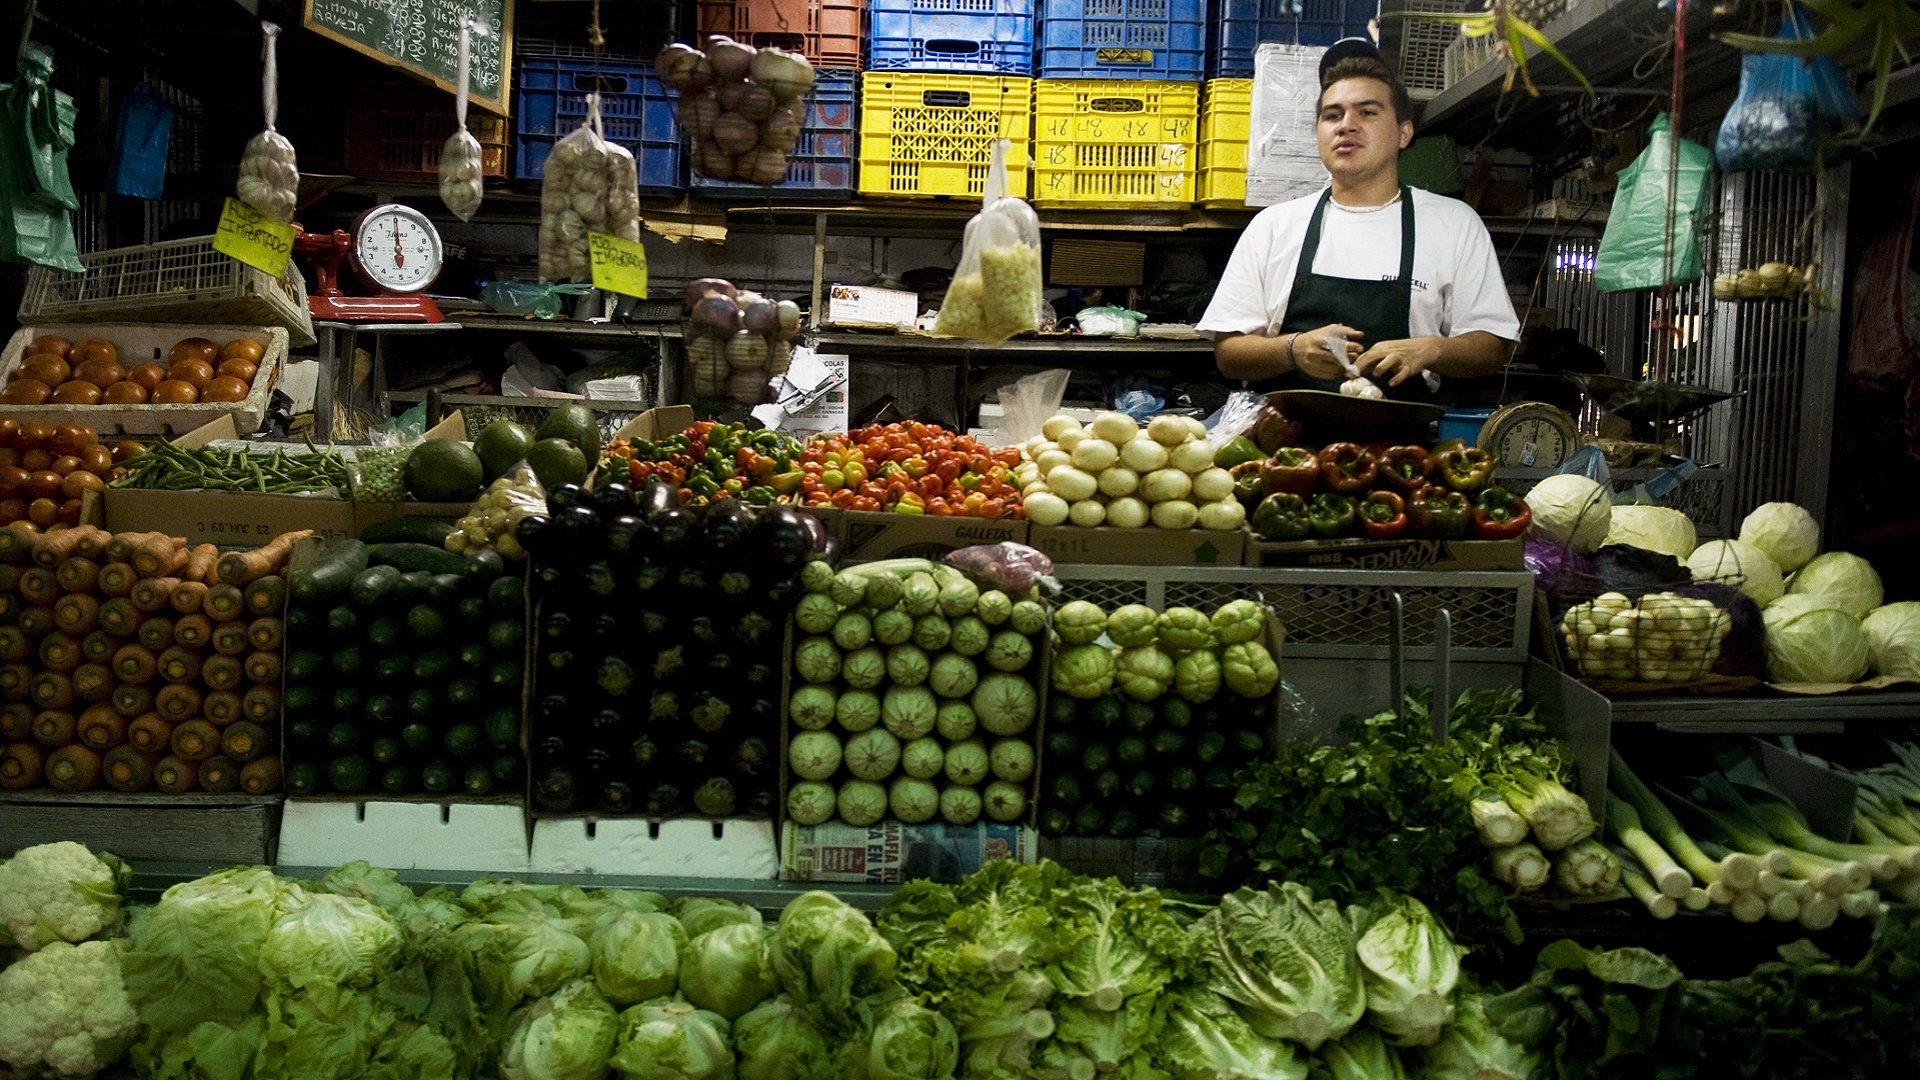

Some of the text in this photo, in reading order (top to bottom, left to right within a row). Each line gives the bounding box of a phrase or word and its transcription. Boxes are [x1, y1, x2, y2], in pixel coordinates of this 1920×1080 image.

[1048, 118, 1190, 138] 48 48 48 48
[1043, 145, 1067, 165] 48
[442, 246, 467, 260] AFÉ
[256, 525, 270, 535] 23
[955, 526, 1015, 540] GALLETAS
[868, 845, 882, 862] EN
